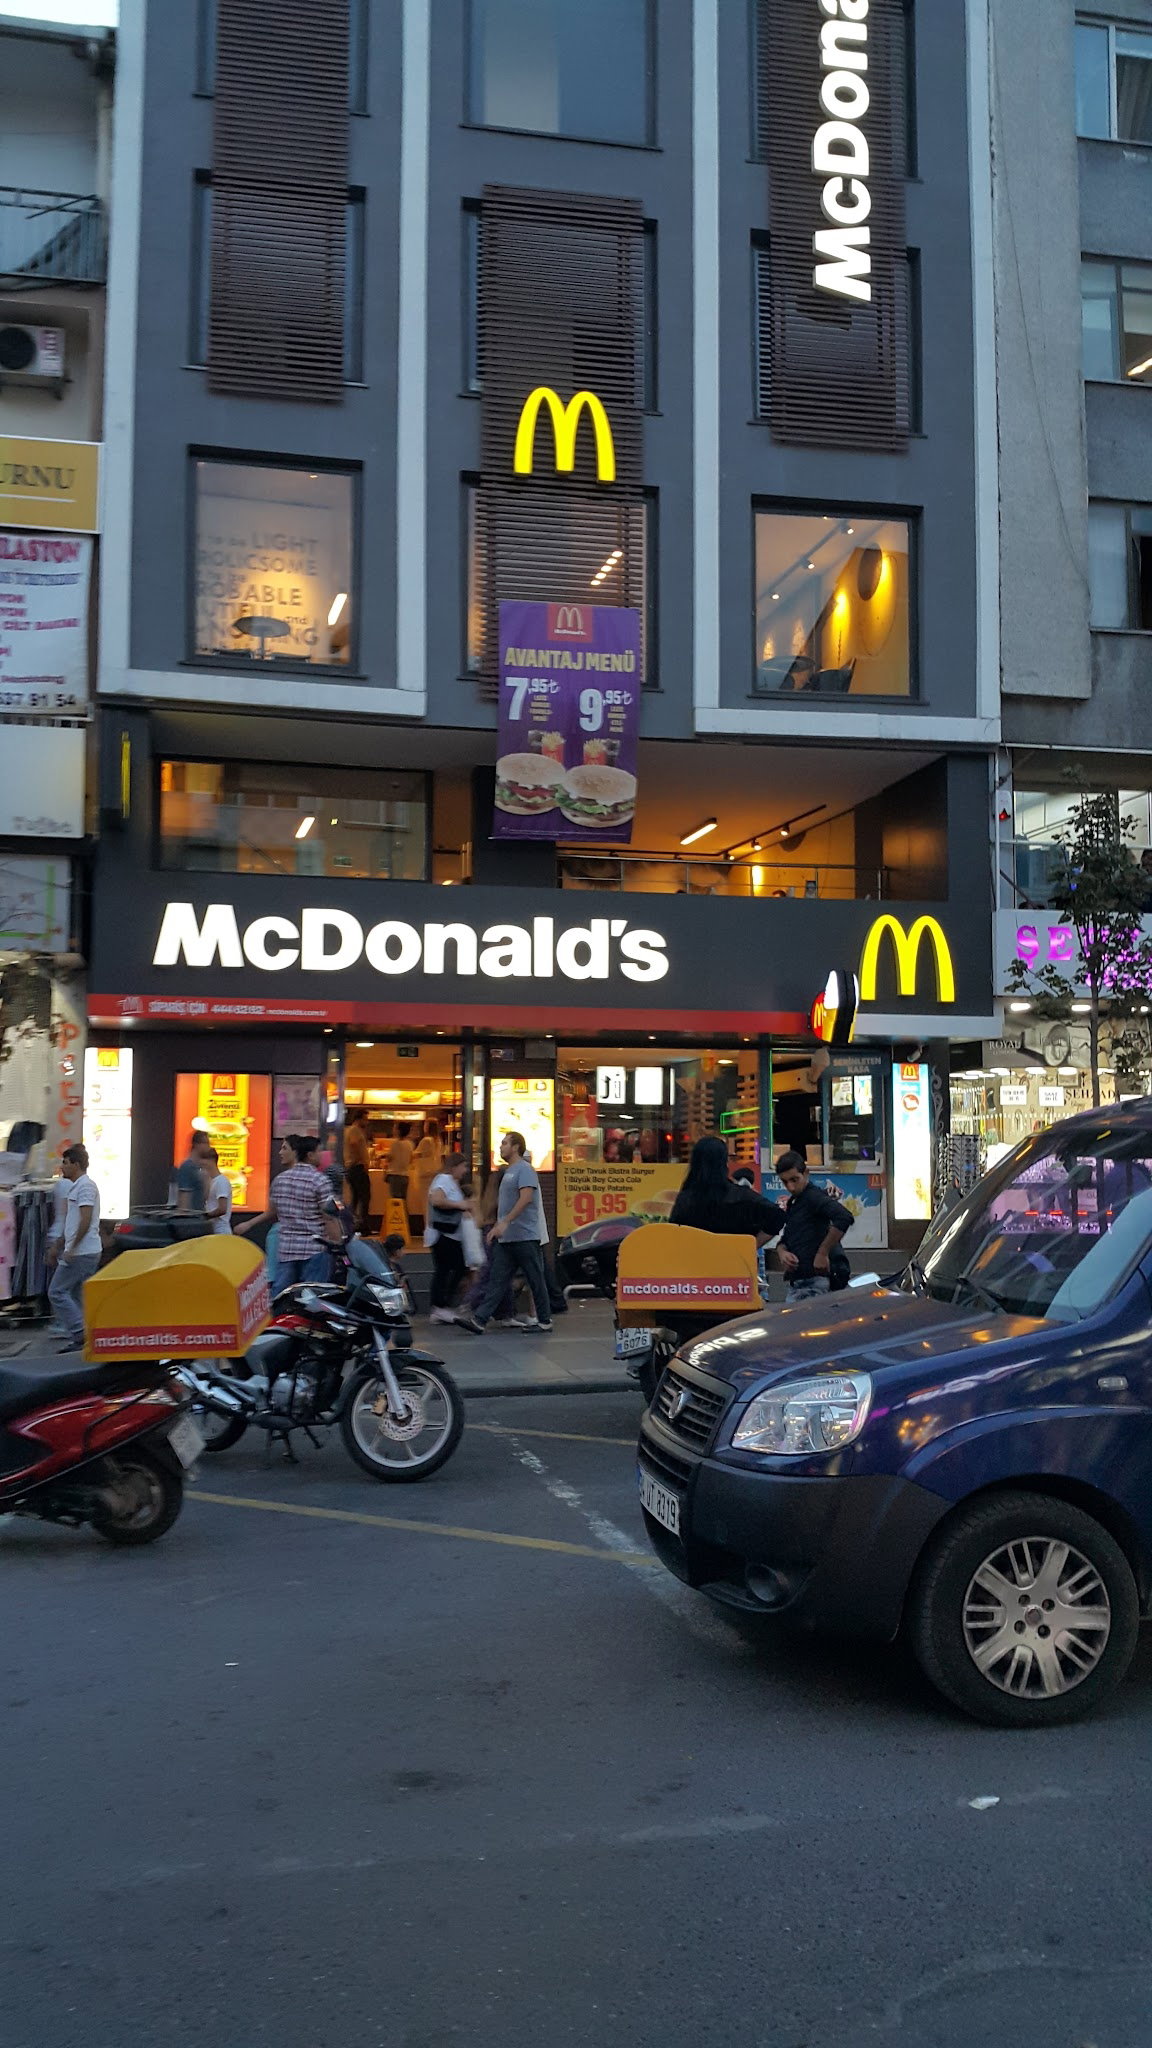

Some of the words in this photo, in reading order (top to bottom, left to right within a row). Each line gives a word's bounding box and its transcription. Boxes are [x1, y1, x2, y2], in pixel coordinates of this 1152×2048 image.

[504, 647, 584, 670] AVANTAJ
[585, 649, 636, 673] MENÜ
[152, 902, 670, 982] McDonald's
[989, 1039, 1021, 1050] ROYAL
[587, 1167, 607, 1175] Tavuk
[631, 1167, 655, 1176] Burger
[592, 1176, 606, 1184] Boy
[592, 1184, 606, 1193] Boy
[623, 1283, 750, 1295] mcdonalds.com.tr
[94, 1331, 236, 1348] mcdonalds.com.tr
[624, 1335, 648, 1350] 6076
